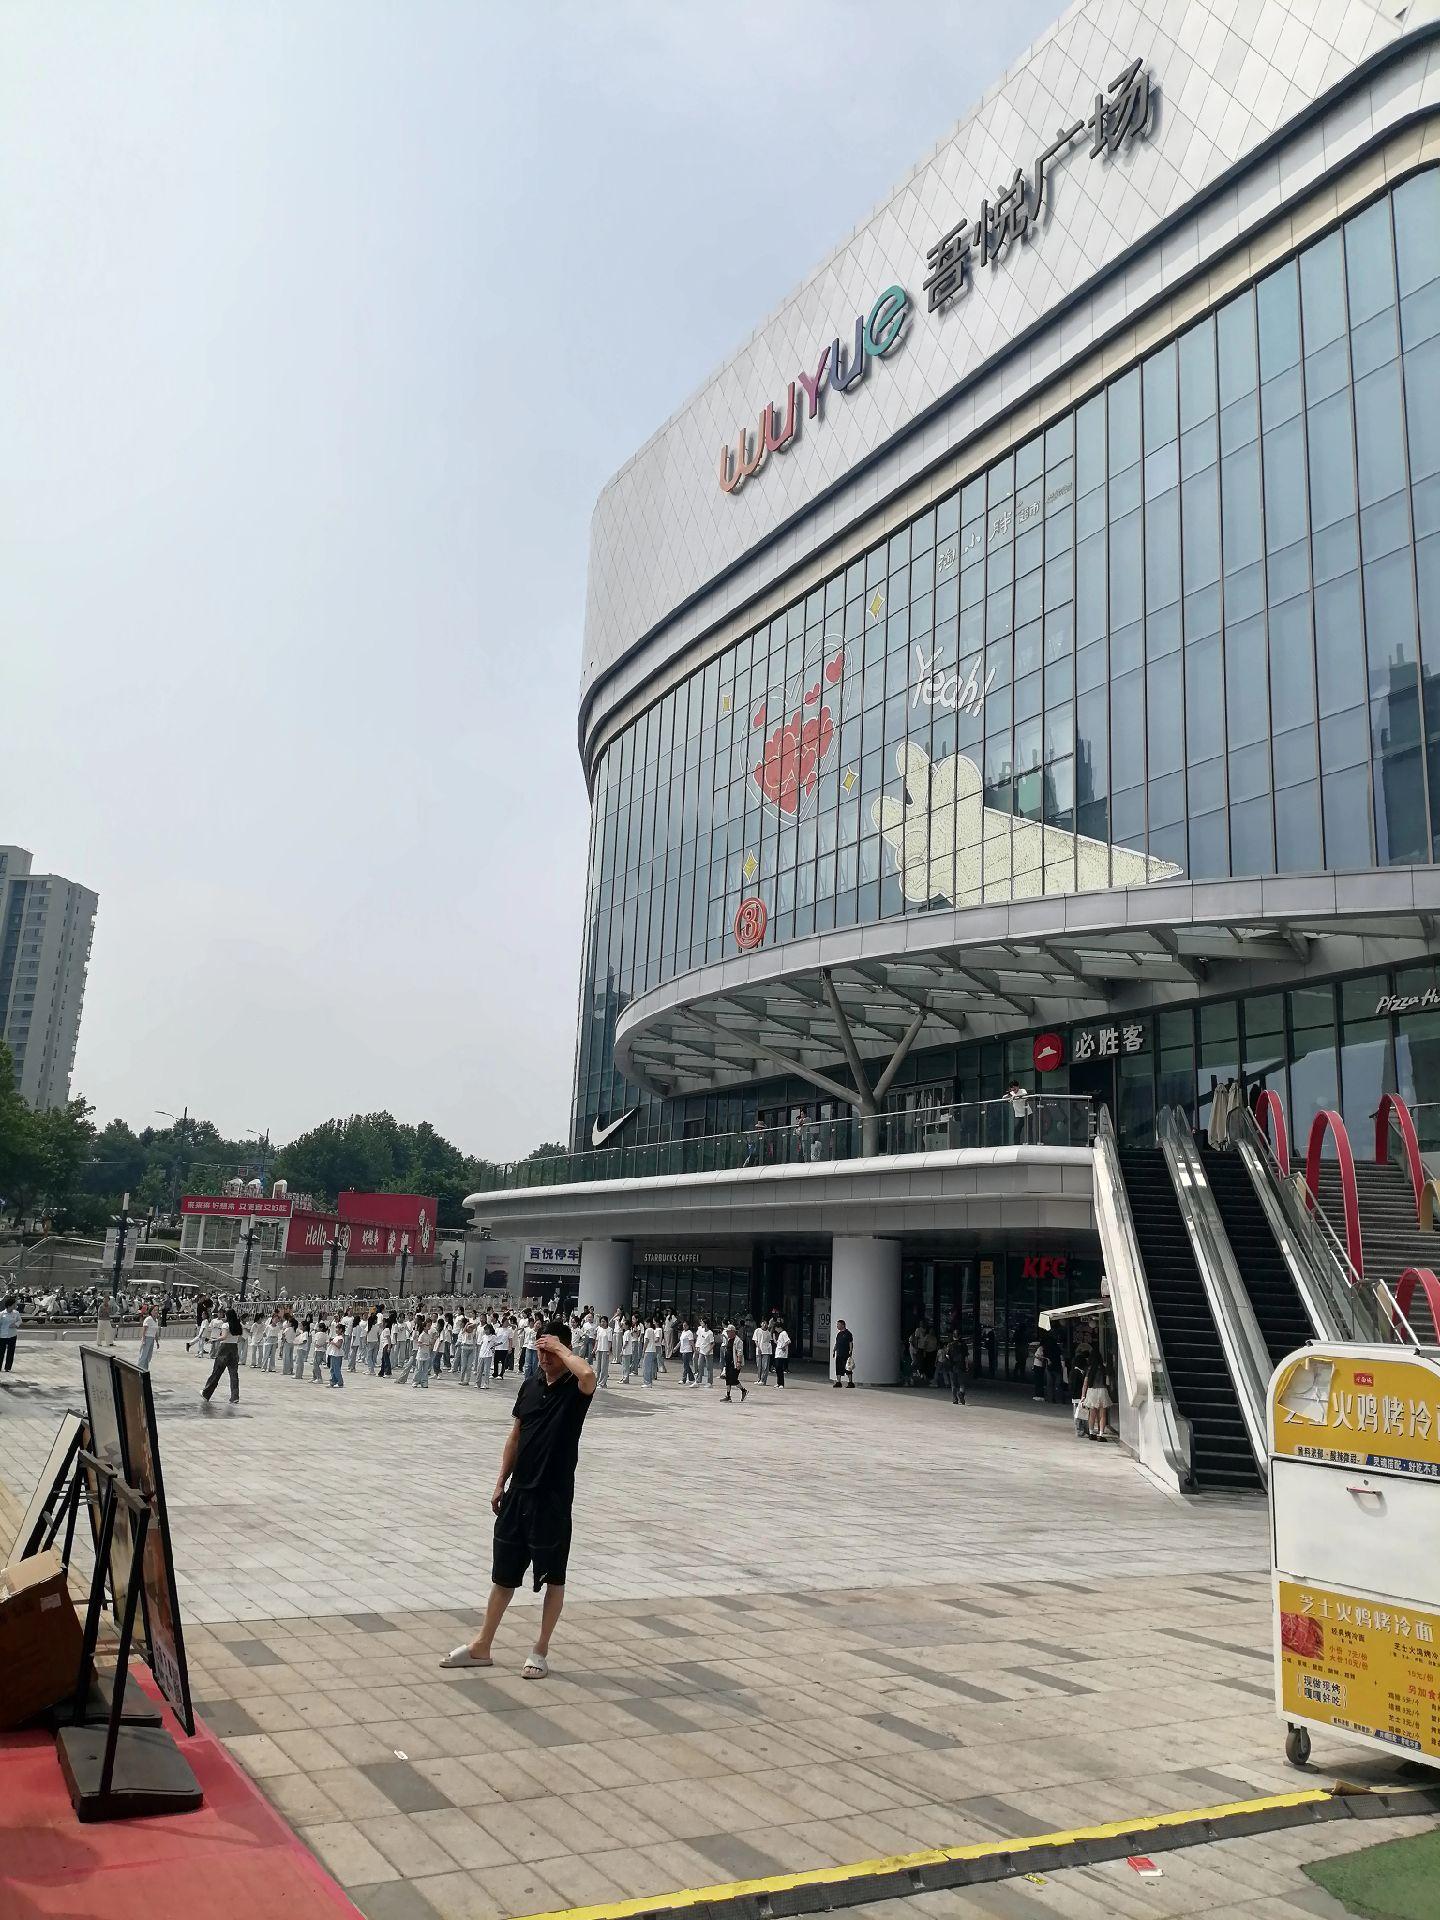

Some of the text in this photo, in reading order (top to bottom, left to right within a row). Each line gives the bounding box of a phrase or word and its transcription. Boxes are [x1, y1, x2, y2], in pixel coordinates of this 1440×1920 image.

[923, 57, 1152, 312] 吾悦广场
[912, 643, 997, 718] Yeah!
[1375, 994, 1419, 1014] Pizza
[1075, 1024, 1145, 1059] 必胜客
[305, 1224, 327, 1246] Hello
[530, 1247, 579, 1261] 吾悦停车
[644, 1253, 677, 1262] STARBUCKS
[1022, 1255, 1068, 1279] KFC
[1284, 1390, 1440, 1442] 火鸡烤冷
[1299, 1594, 1434, 1643] 芝士火鸡烤冷面
[1304, 1675, 1341, 1695] 现做现烤
